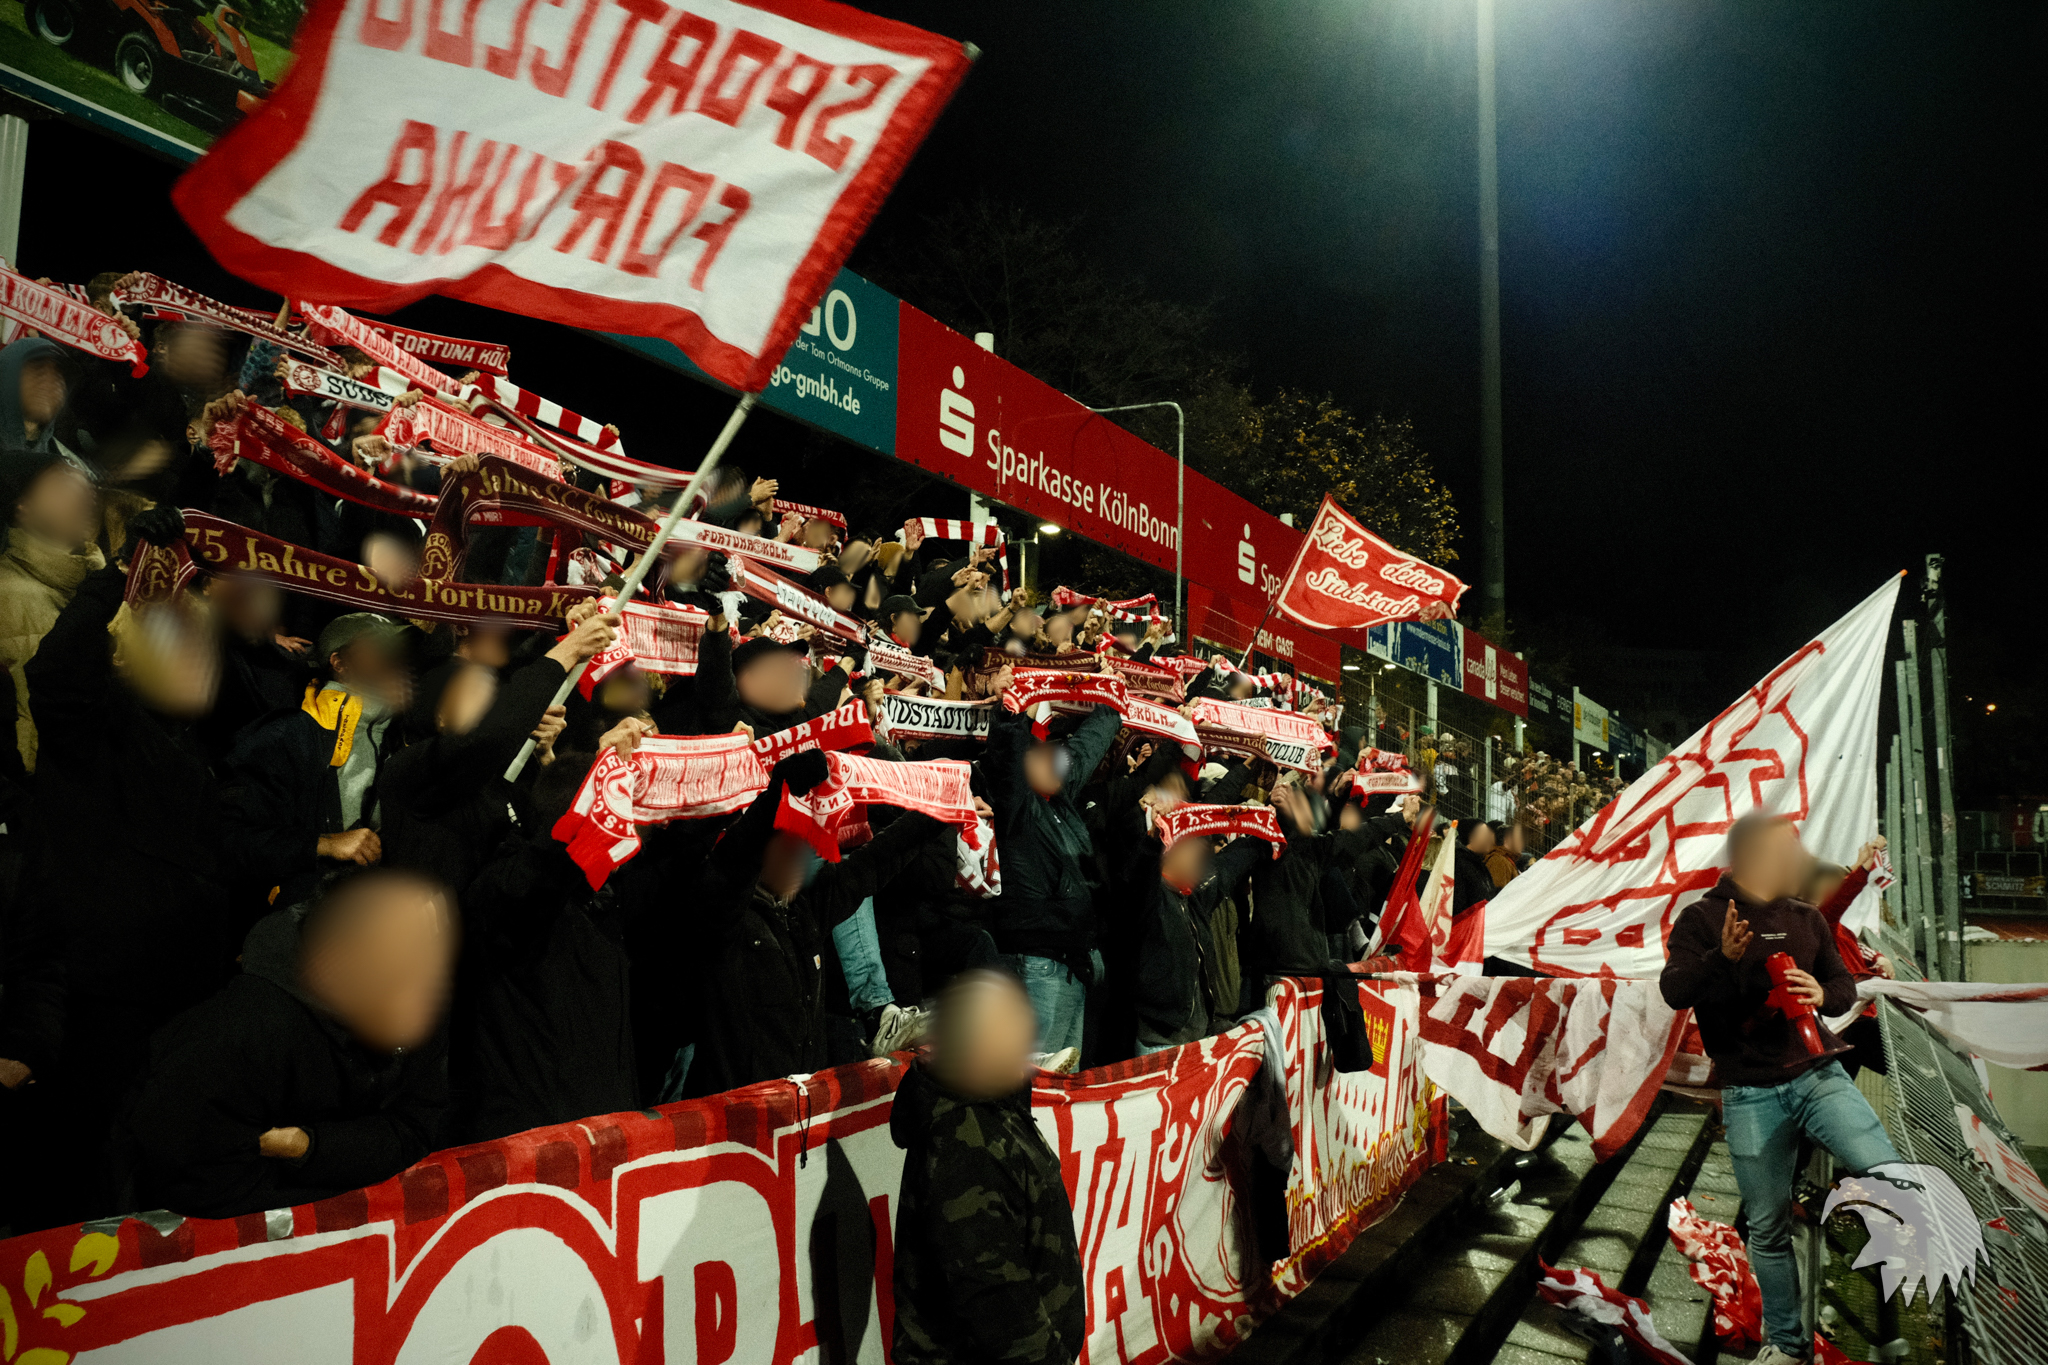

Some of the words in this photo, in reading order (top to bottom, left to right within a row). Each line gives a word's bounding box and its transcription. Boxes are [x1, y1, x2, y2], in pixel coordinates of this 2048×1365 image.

[392, 331, 476, 362] FORTUNA
[477, 347, 508, 370] KÖL
[810, 342, 825, 360] Tom
[827, 351, 862, 378] Ortmanns
[863, 369, 889, 391] Gruppe
[986, 428, 1094, 514] Sparkasse
[1099, 483, 1180, 553] KölnBonn
[584, 495, 659, 543] Fortuna
[702, 528, 754, 551] FORTUNA
[761, 542, 789, 562] KÖLN
[1314, 516, 1369, 569] Liebe
[1380, 561, 1444, 595] deine
[239, 536, 348, 586] Jahre
[424, 577, 543, 617] Fortuna
[1275, 635, 1294, 658] GAST
[1137, 706, 1168, 726] KÖLN
